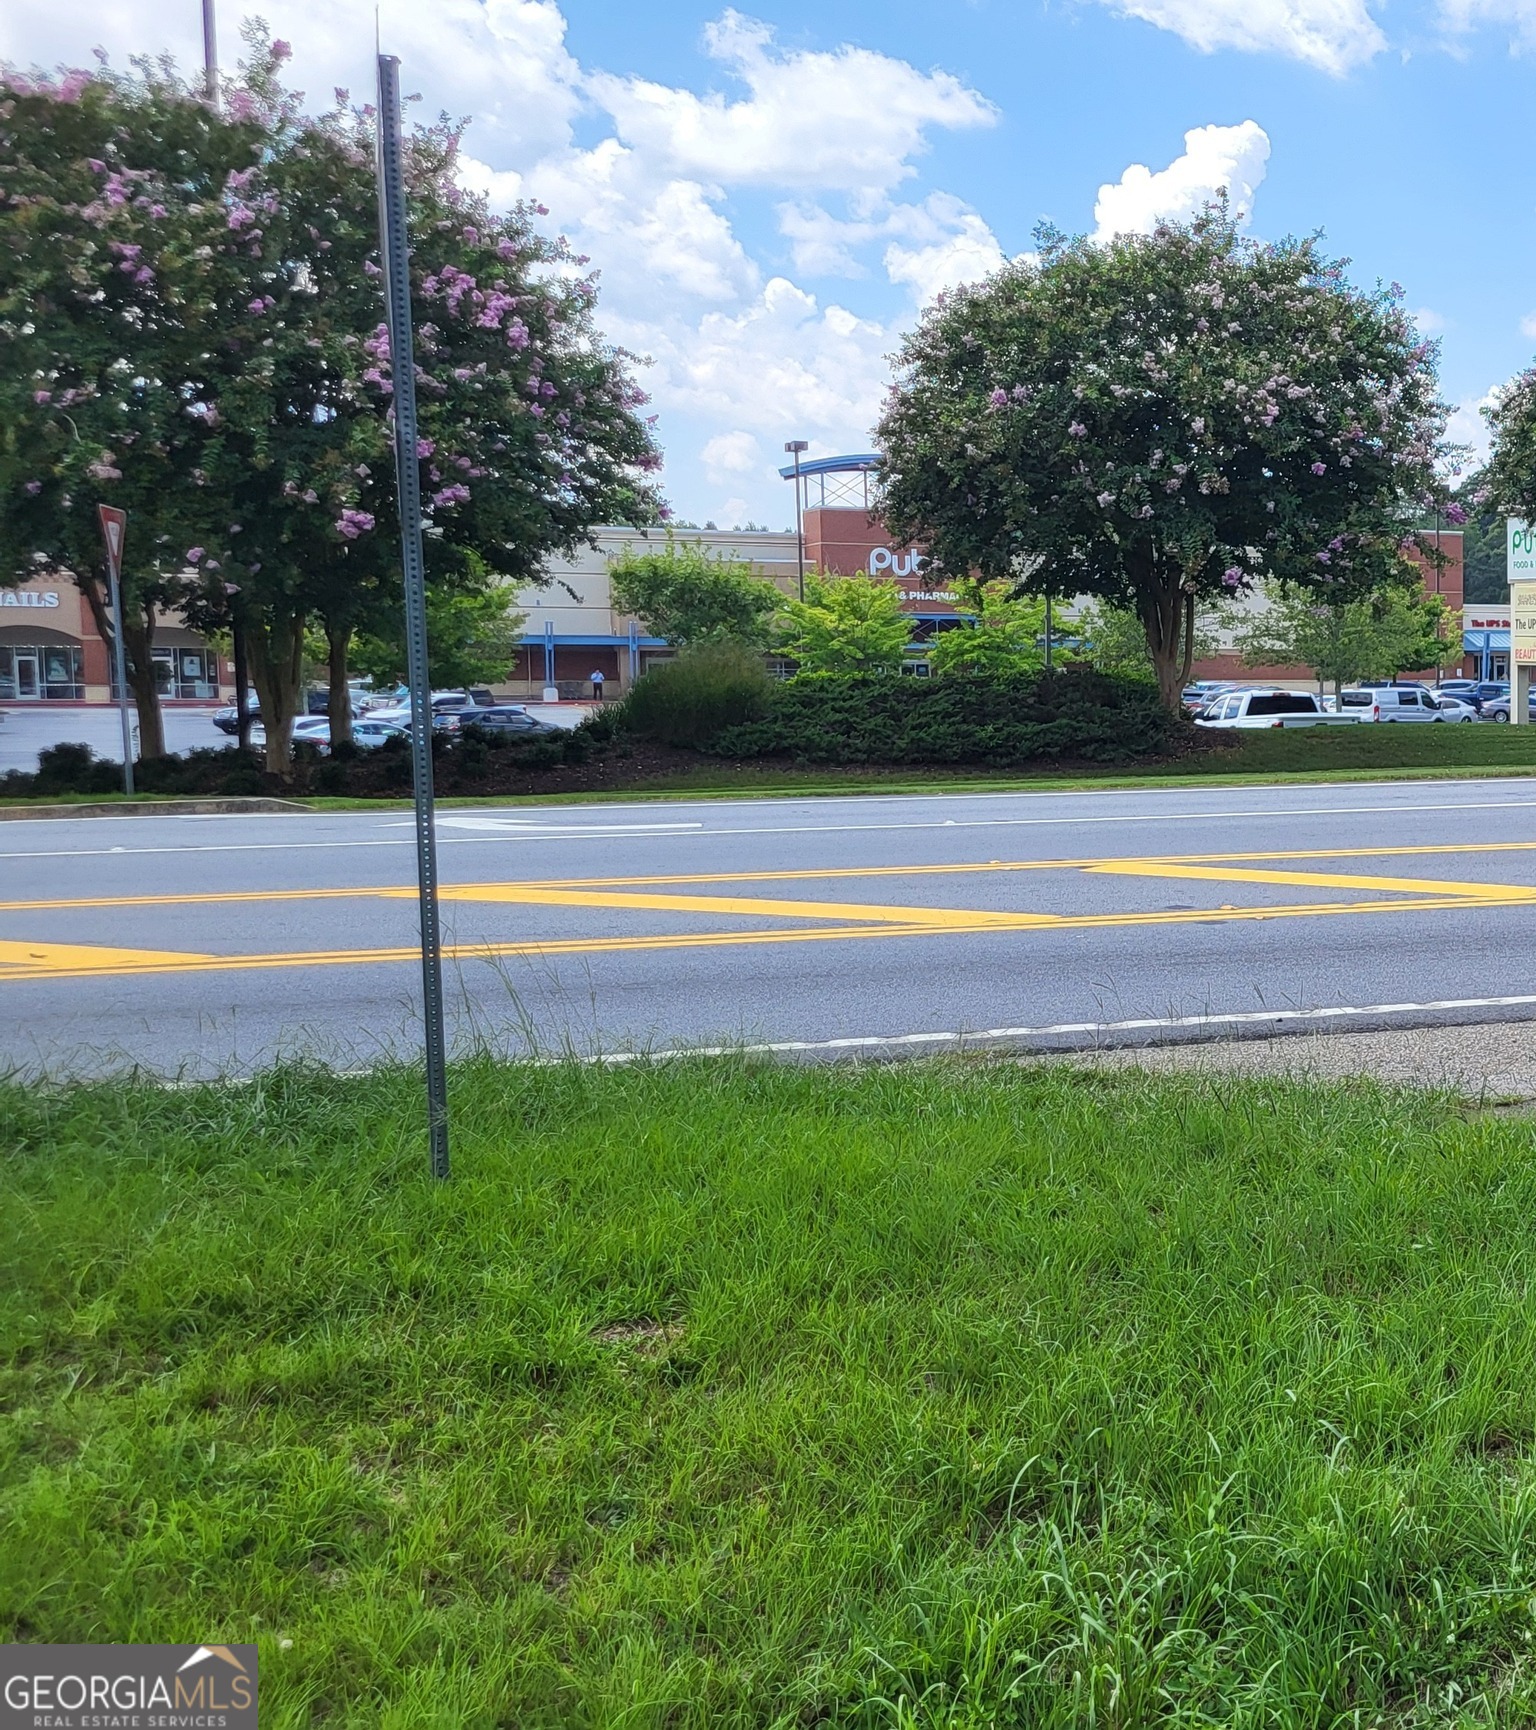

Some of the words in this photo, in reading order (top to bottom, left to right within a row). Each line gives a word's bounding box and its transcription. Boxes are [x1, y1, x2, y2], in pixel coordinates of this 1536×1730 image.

[869, 547, 930, 577] Pub
[909, 591, 960, 601] PHARMA
[1471, 619, 1485, 628] The
[1486, 619, 1500, 628] UPS
[1515, 618, 1526, 630] The
